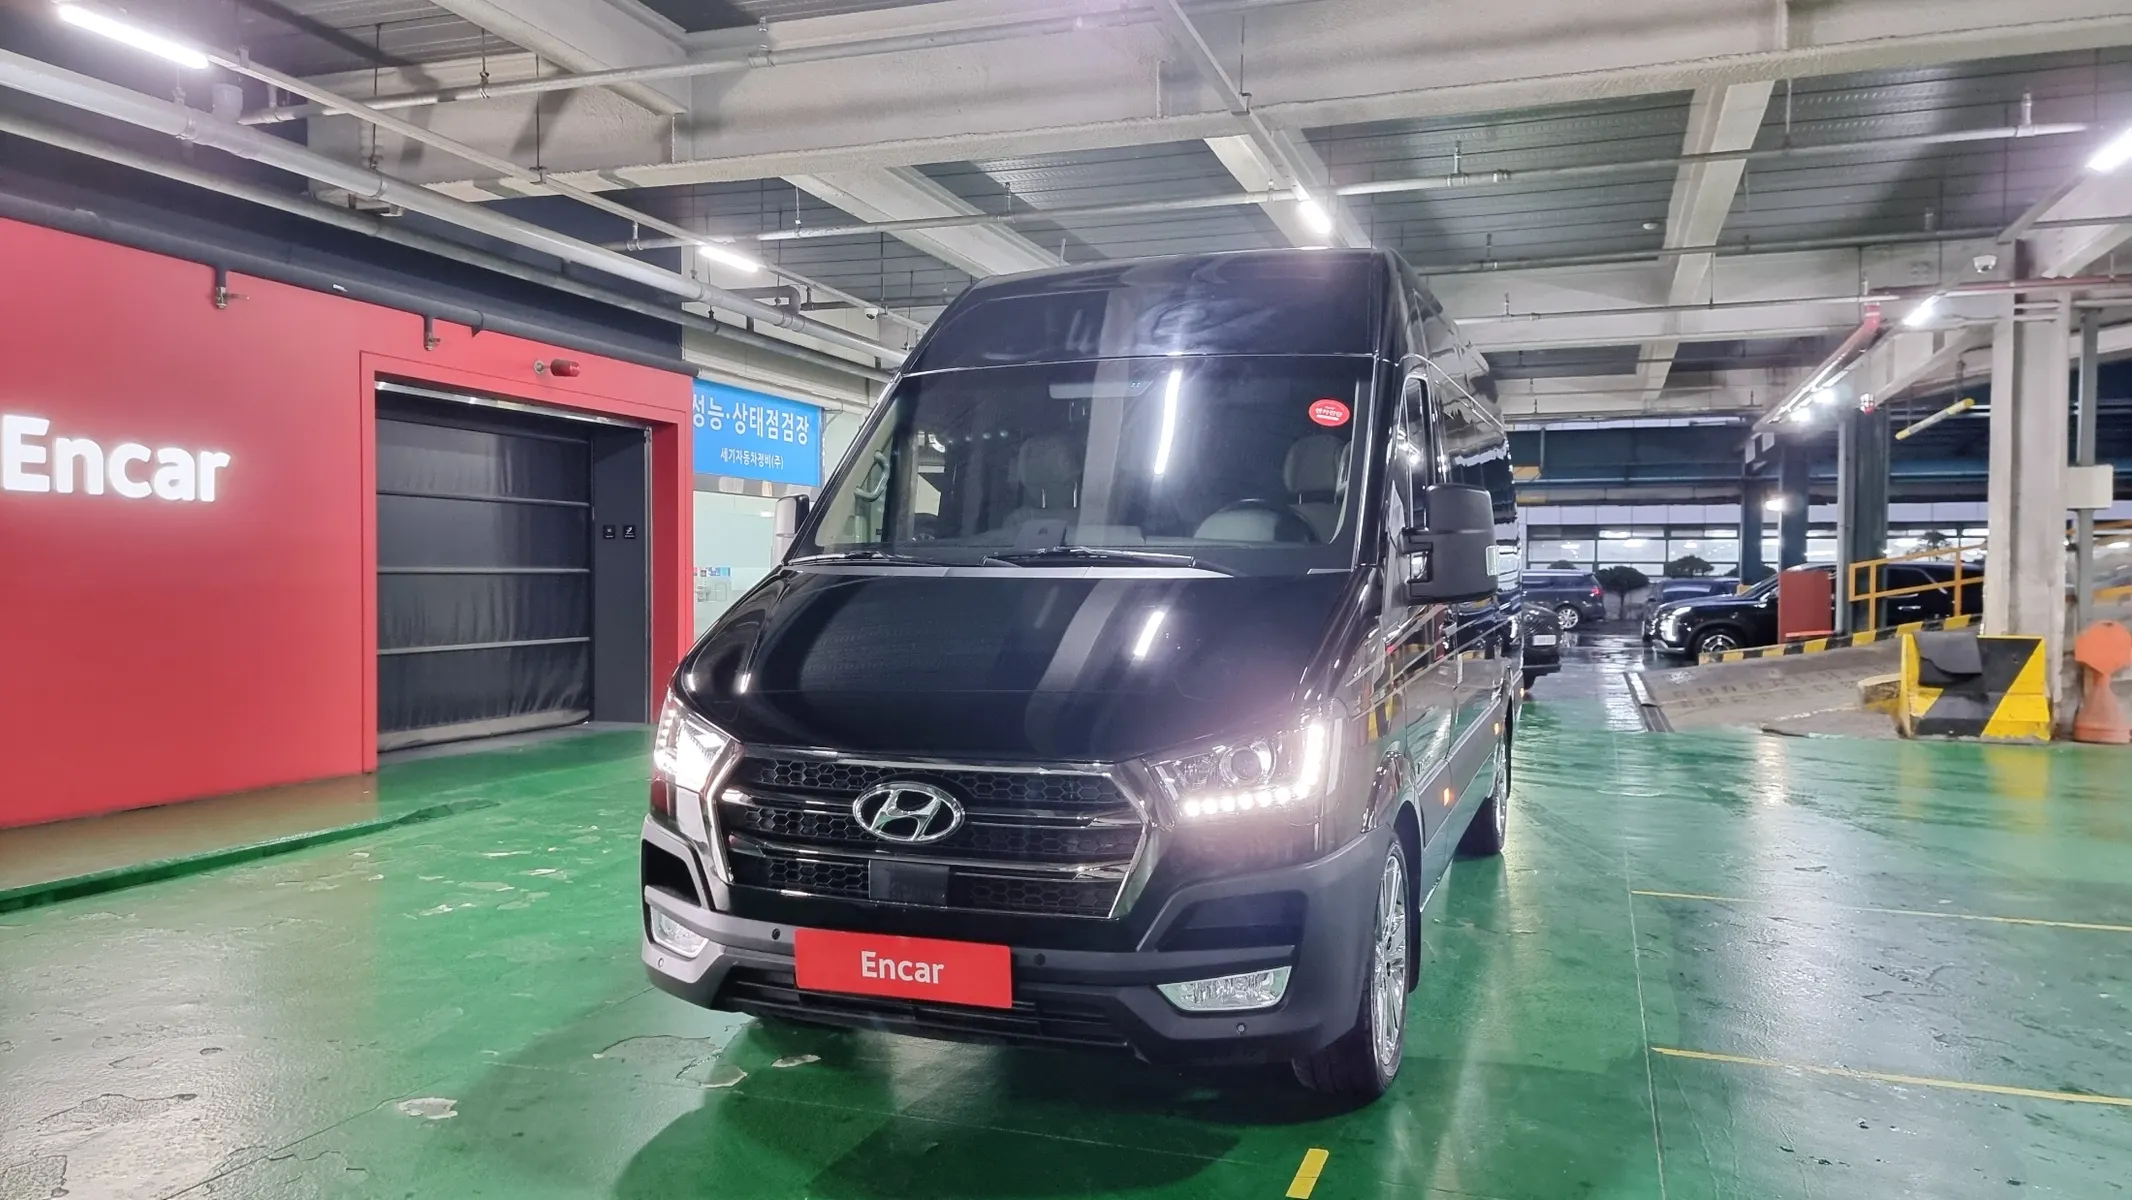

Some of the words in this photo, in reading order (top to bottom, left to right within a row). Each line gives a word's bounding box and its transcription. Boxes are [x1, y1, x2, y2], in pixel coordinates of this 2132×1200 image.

[693, 394, 809, 445] 성능·상태점검장
[2, 414, 231, 502] Encar
[861, 950, 944, 984] Encar
